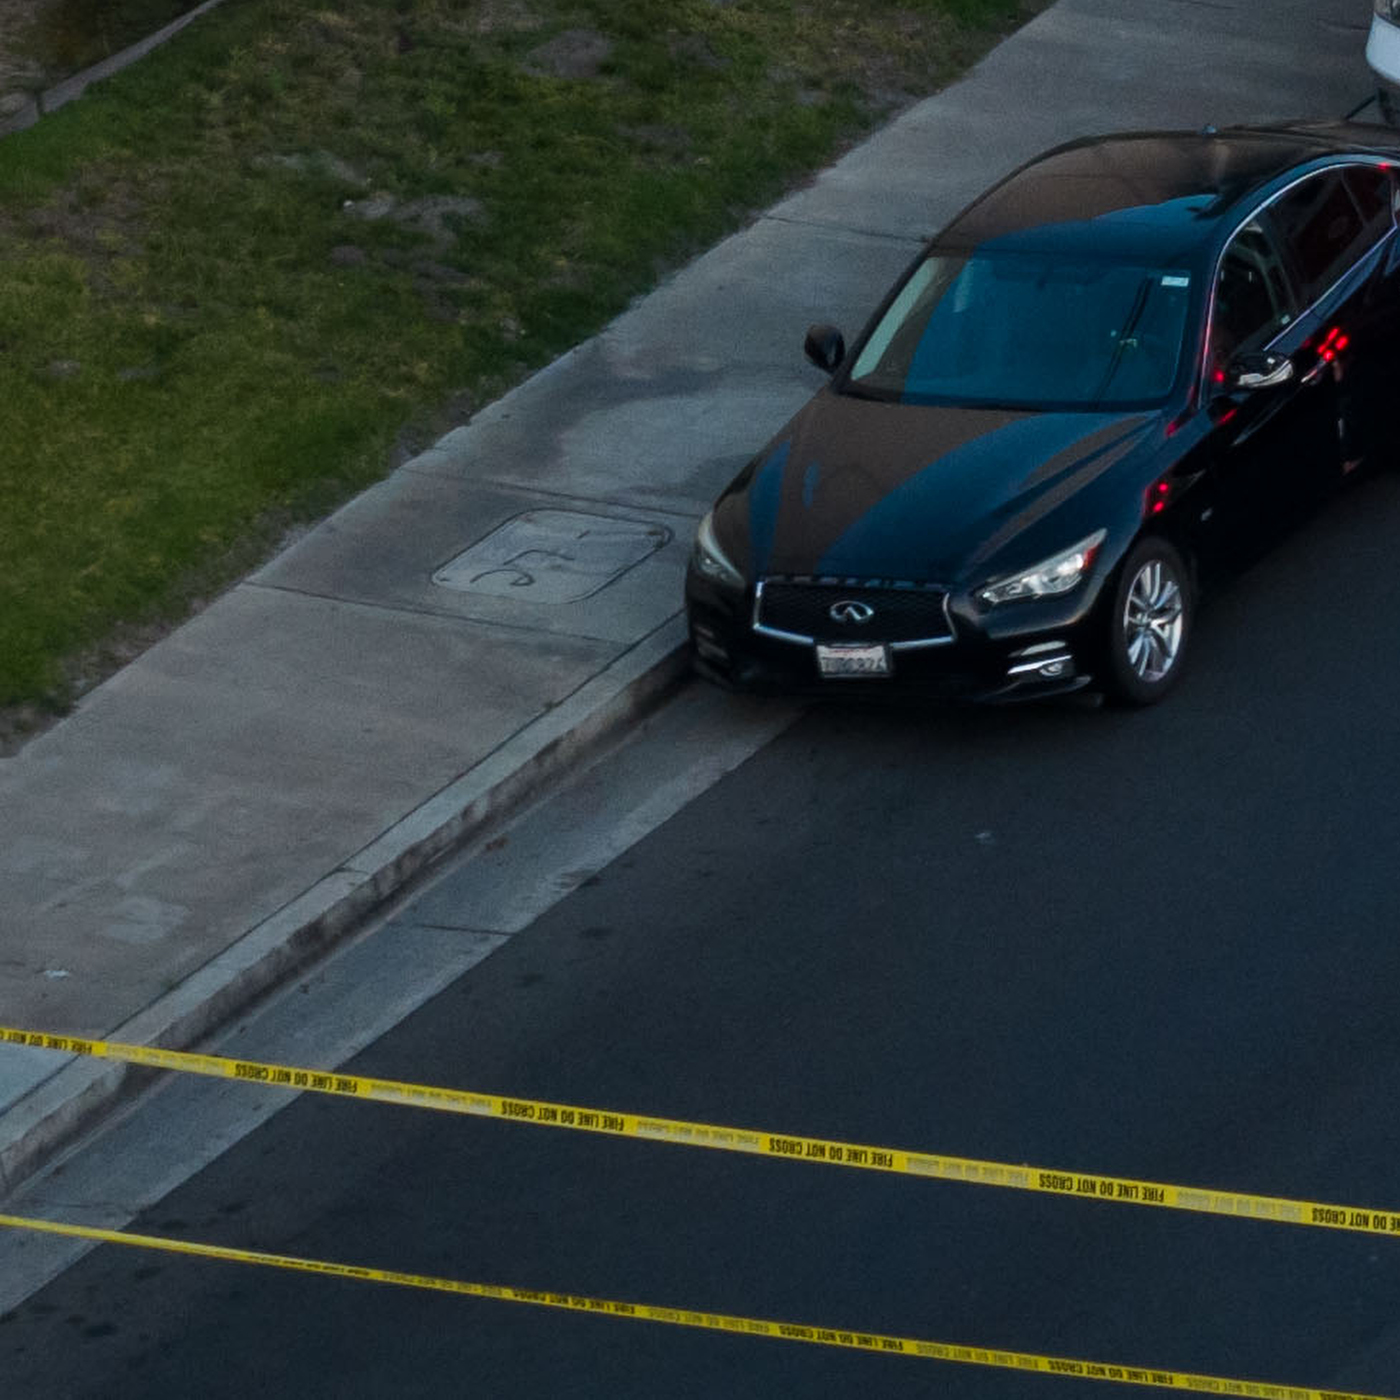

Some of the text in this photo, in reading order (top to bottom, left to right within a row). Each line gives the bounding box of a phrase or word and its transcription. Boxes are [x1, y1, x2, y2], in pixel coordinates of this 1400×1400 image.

[768, 1137, 894, 1167] FIRE LINE DO NOT CROSS
[1038, 1173, 1165, 1202] FIRE LINE DO NOT CROSS
[1311, 1207, 1346, 1225] CROSS
[1349, 1211, 1369, 1228] NOT
[1373, 1215, 1386, 1230] DO
